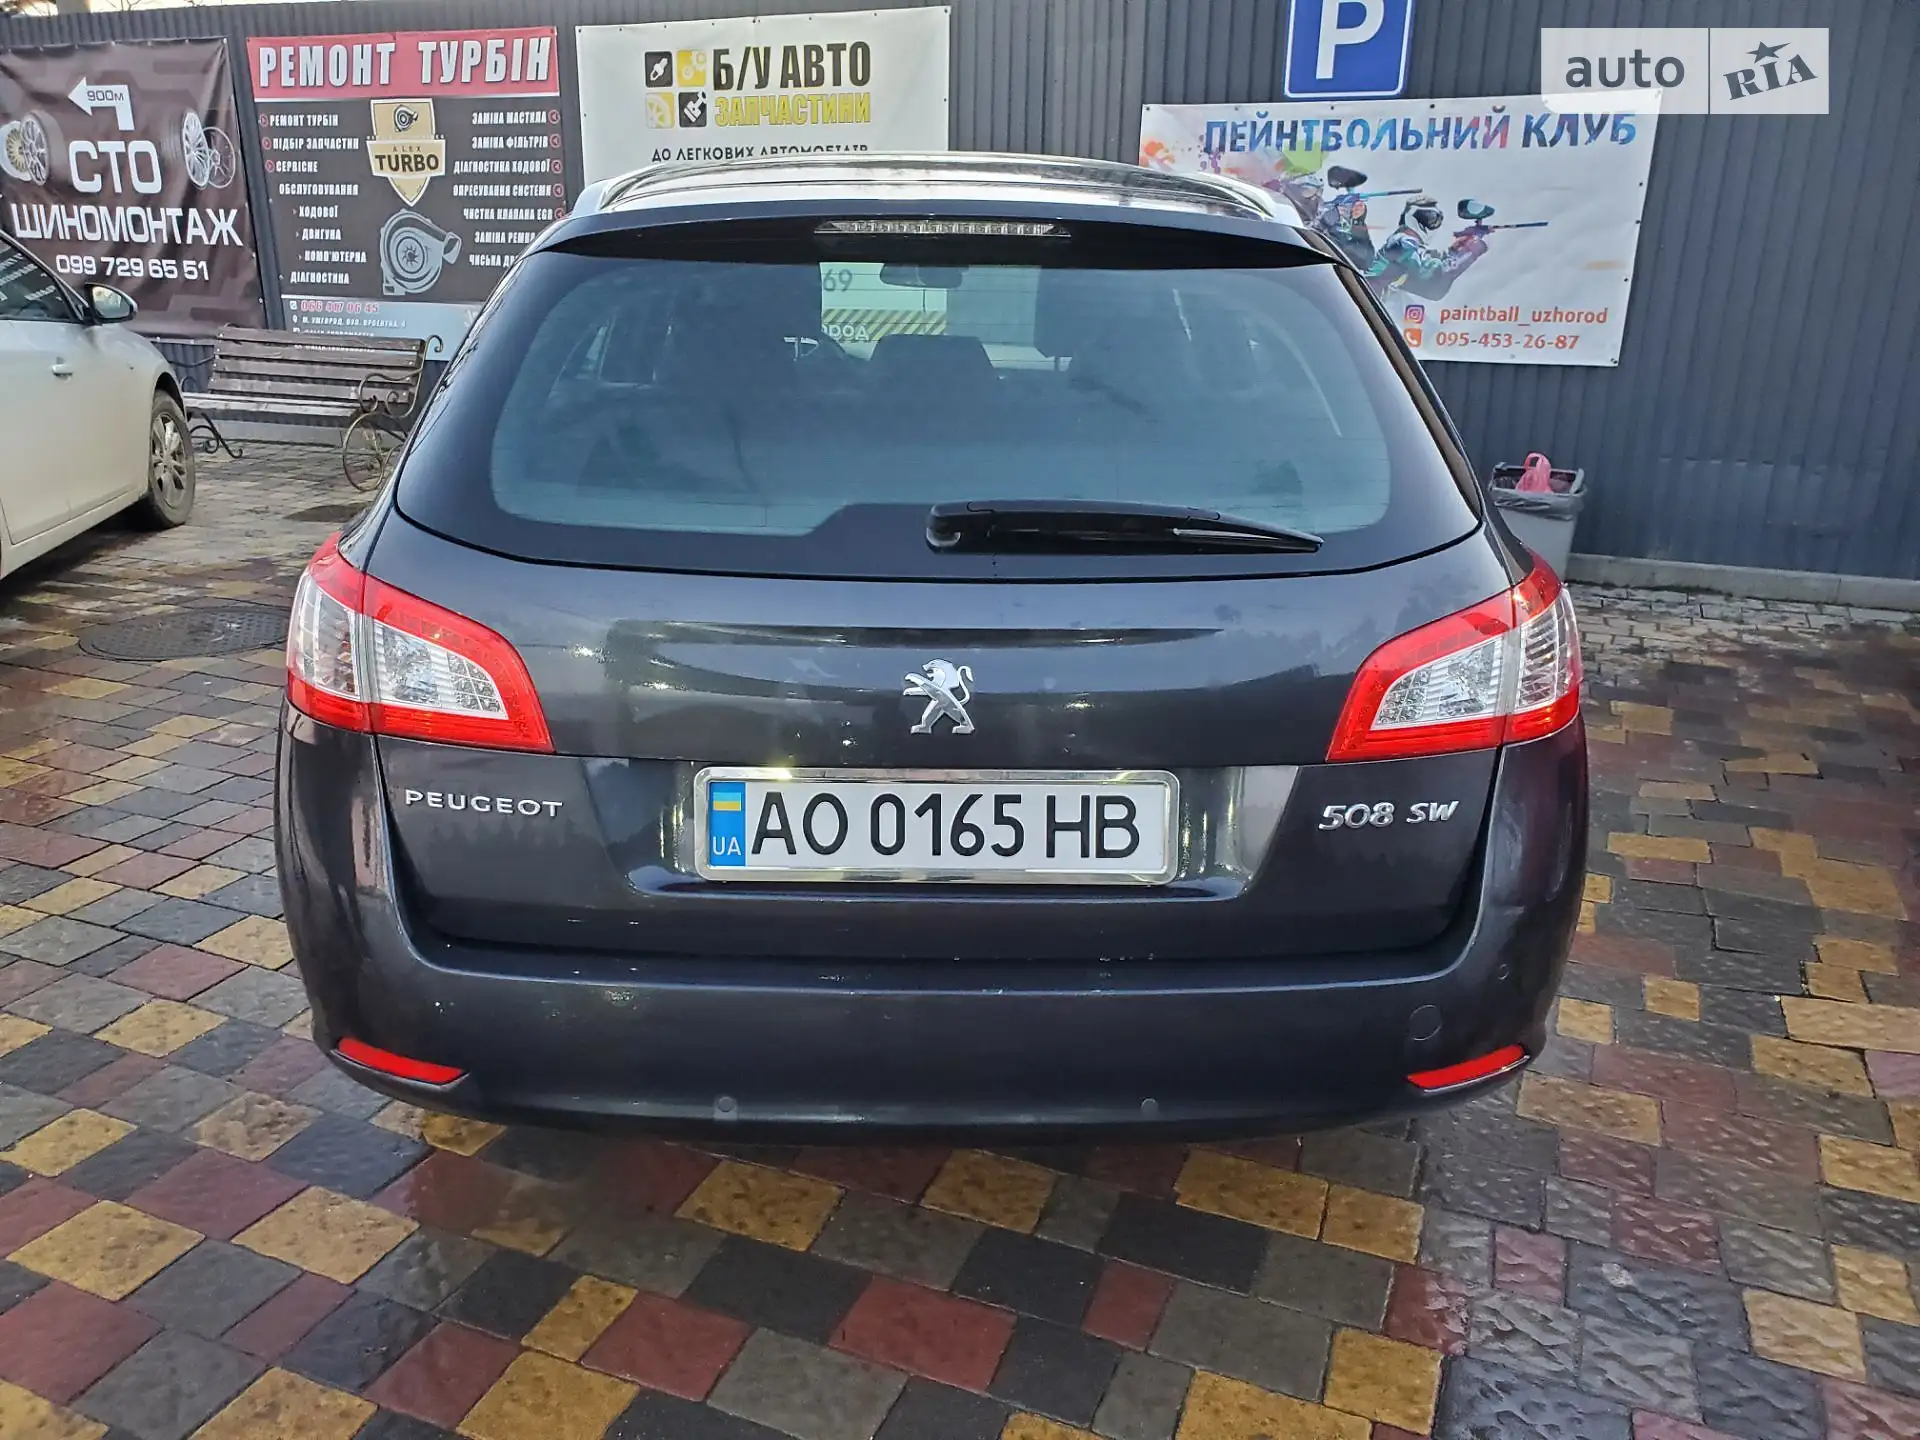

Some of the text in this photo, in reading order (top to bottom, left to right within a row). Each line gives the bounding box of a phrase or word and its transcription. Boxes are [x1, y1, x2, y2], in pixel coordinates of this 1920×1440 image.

[1316, 0, 1384, 79] P
[259, 36, 551, 88] РЕМОНТ ТУРБІН
[713, 41, 871, 91] Б/У АВТО
[269, 114, 339, 127] РЕМОНТ ТУРБІН
[472, 111, 547, 125] ЗАМІНА МАСТИЛА
[714, 92, 871, 127] ЗАПЧАСТИНИ
[471, 136, 505, 149] ЗАМІНА
[1204, 104, 1637, 152] ПЕЙНТБОЛЬНИЙ КЛУБ
[68, 140, 163, 194] СТО
[374, 154, 439, 173] TURBO
[651, 148, 671, 163] ДО
[675, 146, 756, 161] ЛЕГКОВИХ
[11, 203, 244, 247] ШИНОМОНТАЖ
[56, 254, 97, 276] 099
[101, 256, 144, 278] 729
[150, 259, 178, 279] 65
[183, 260, 209, 281] 51
[1439, 304, 1609, 327] paintball_uzhorod
[1436, 331, 1580, 350] 095-453-26-87
[404, 788, 564, 818] PEUGEOT
[1318, 800, 1460, 831] 508 SW
[750, 791, 1141, 860] AO 0165 HB
[712, 836, 742, 857] UA
